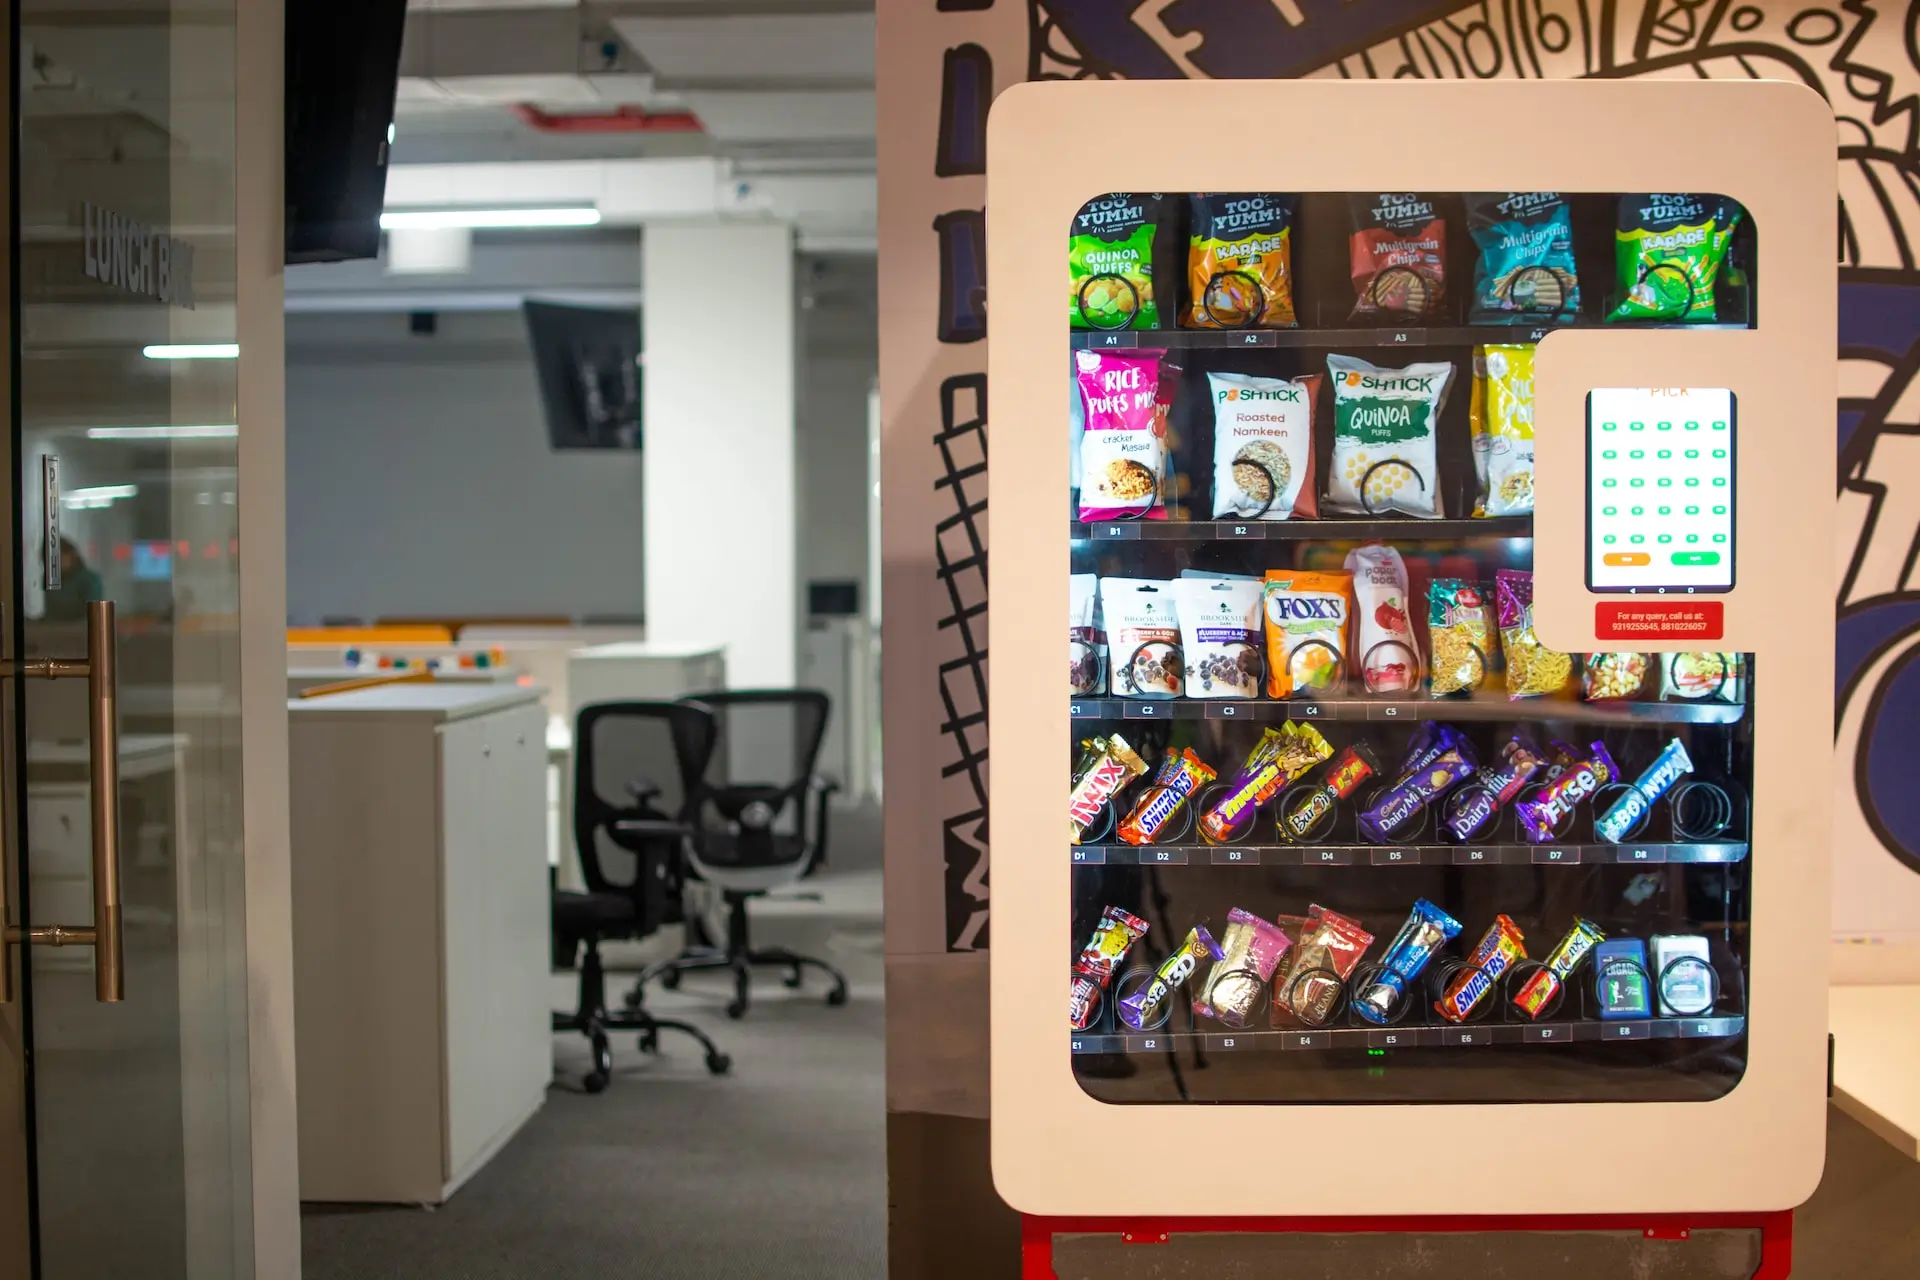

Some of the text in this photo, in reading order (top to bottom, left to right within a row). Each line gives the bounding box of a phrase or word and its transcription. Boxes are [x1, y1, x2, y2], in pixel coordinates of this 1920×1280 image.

[1088, 198, 1127, 212] TOO
[1225, 198, 1265, 214] TOO
[1380, 193, 1416, 207] TOO
[1650, 194, 1685, 206] TOO
[1078, 206, 1143, 227] YUMM!
[1371, 202, 1433, 220] YUMM!
[1640, 203, 1704, 221] YUMM!
[1214, 207, 1280, 229] YUMM!
[1500, 222, 1568, 249] Multigrain
[1643, 229, 1705, 250] KARARE
[84, 200, 153, 296] LUNCH
[1216, 237, 1281, 260] KARARE
[1373, 238, 1438, 255] Multigrain
[1515, 242, 1547, 260] Chips
[1086, 249, 1139, 264] QUINOA
[1388, 251, 1420, 266] Chips
[1093, 262, 1132, 275] PUFFS
[1245, 335, 1257, 343] A2
[1395, 334, 1407, 342] A3
[1531, 331, 1543, 339] A4
[1105, 367, 1141, 392] RICE
[1236, 413, 1285, 422] Roasted
[1233, 427, 1288, 437] Namkeen
[1371, 429, 1392, 437] PUFFS
[49, 466, 57, 577] PUSH
[1110, 527, 1120, 535] B1
[1235, 527, 1247, 535] B2
[1617, 611, 1630, 620] For
[1631, 613, 1644, 621] any
[1669, 611, 1682, 620] call
[1071, 706, 1081, 714] C1
[1223, 707, 1235, 715] C3
[1071, 757, 1125, 827] TWIX
[1379, 806, 1409, 832] Dairy
[1456, 801, 1492, 835] Dairy
[1229, 852, 1242, 860] D3
[1321, 852, 1334, 860] D4
[1390, 852, 1401, 860] D5
[1471, 852, 1483, 860] D6
[1550, 851, 1562, 859] D7
[1456, 952, 1507, 1014] SNICKERS
[1542, 1030, 1553, 1038] E7
[1620, 1027, 1631, 1035] E8
[1698, 1024, 1708, 1033] E9
[1145, 1040, 1155, 1048] E2
[1301, 1037, 1311, 1045] E4
